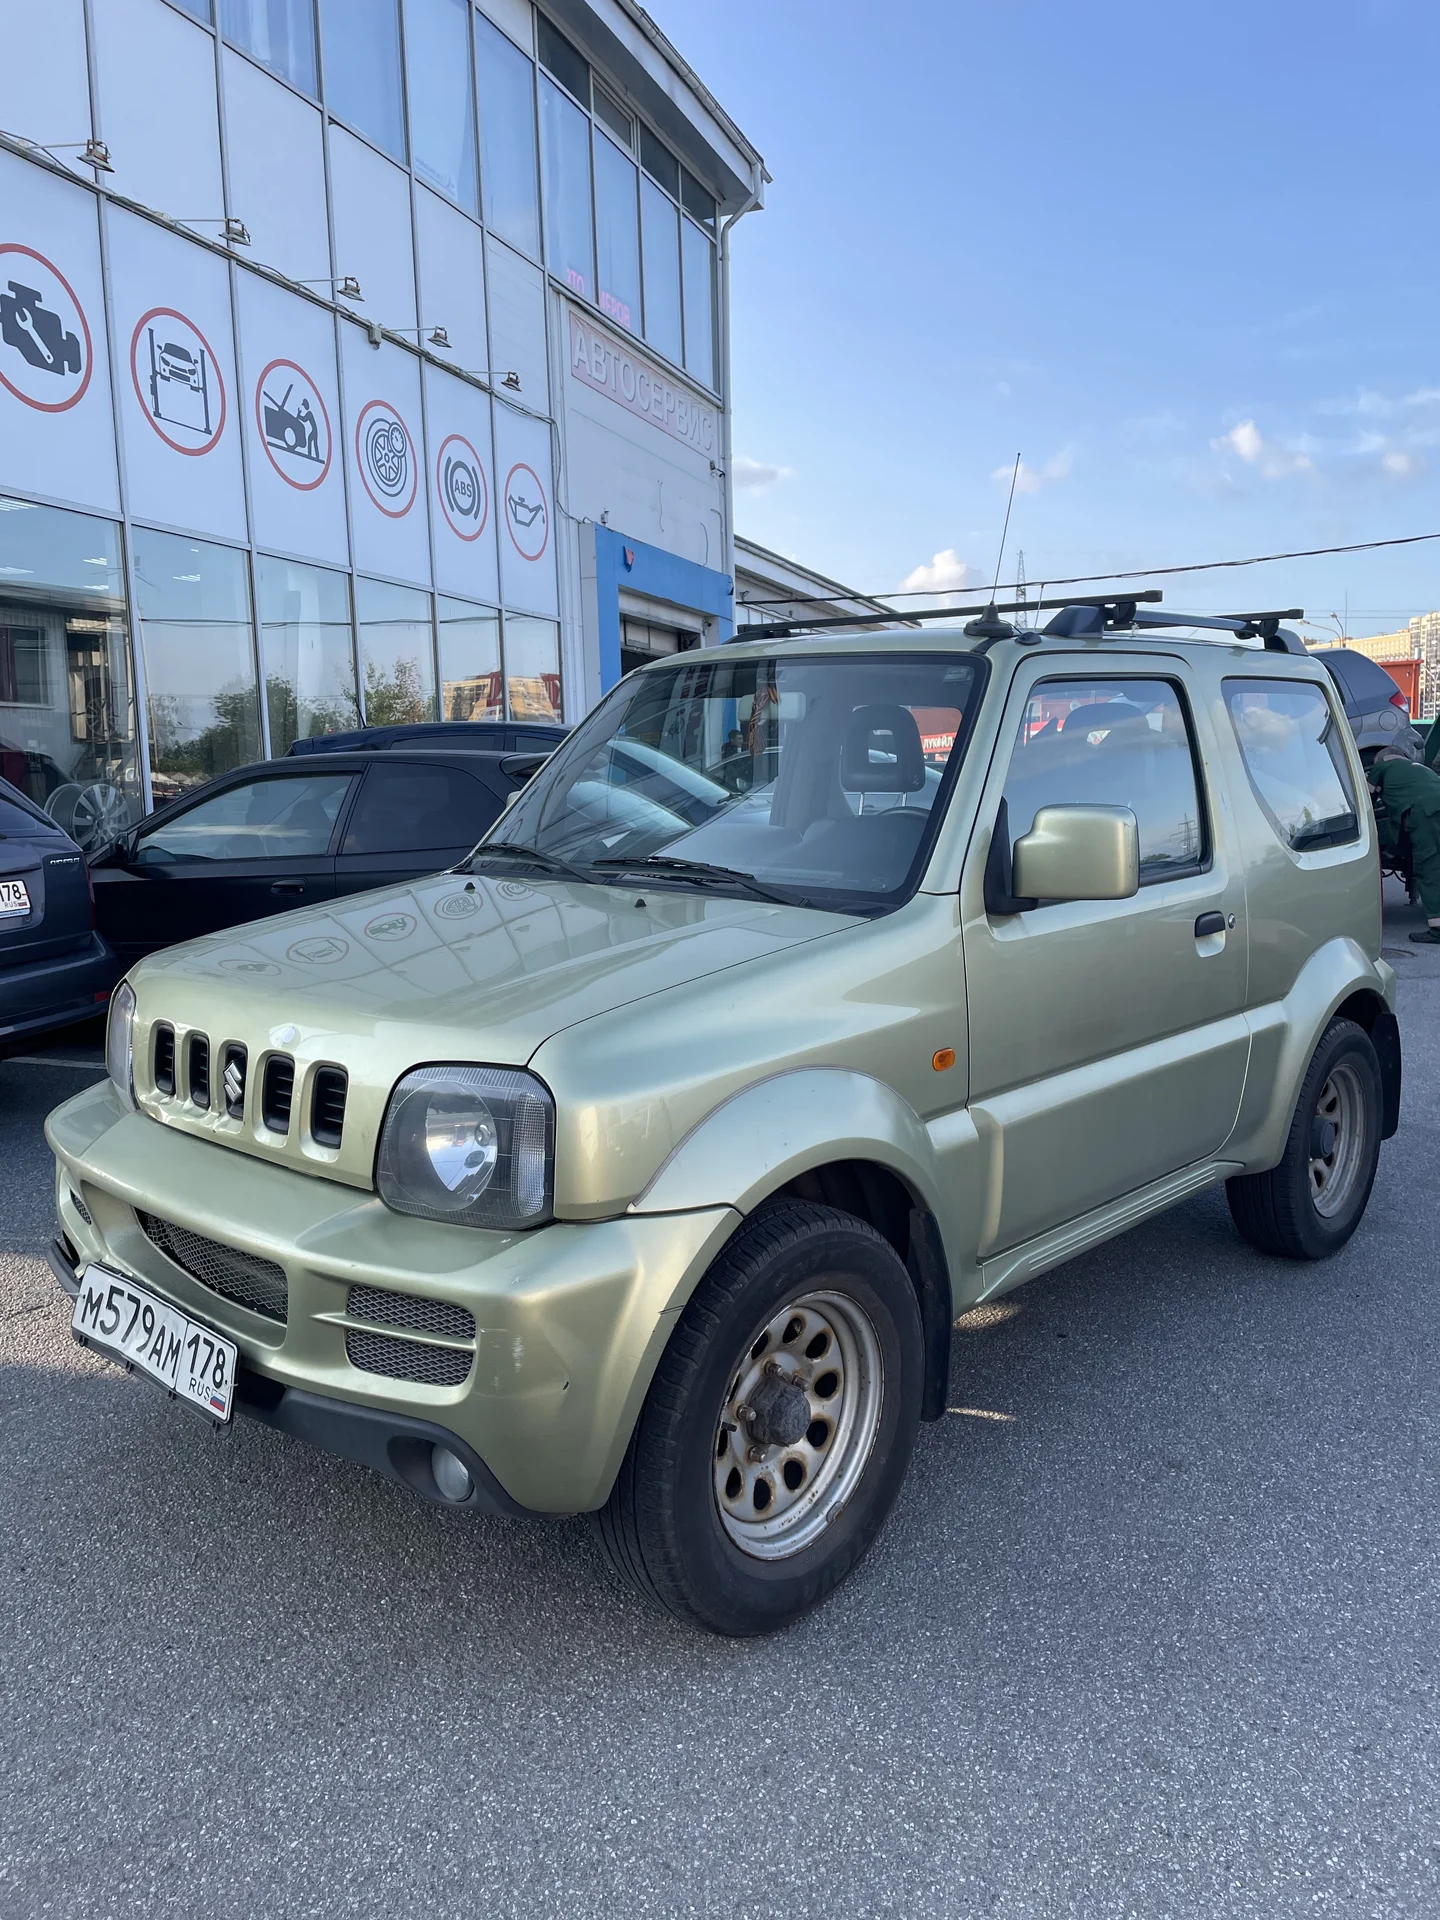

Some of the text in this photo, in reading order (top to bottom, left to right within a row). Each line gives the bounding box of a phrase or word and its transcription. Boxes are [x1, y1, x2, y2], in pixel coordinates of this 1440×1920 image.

[574, 326, 713, 451] АВТОСЕРВИС
[454, 479, 472, 498] ABS
[4, 901, 18, 909] RUS
[187, 1333, 226, 1389] 178
[188, 1377, 211, 1401] RUS
